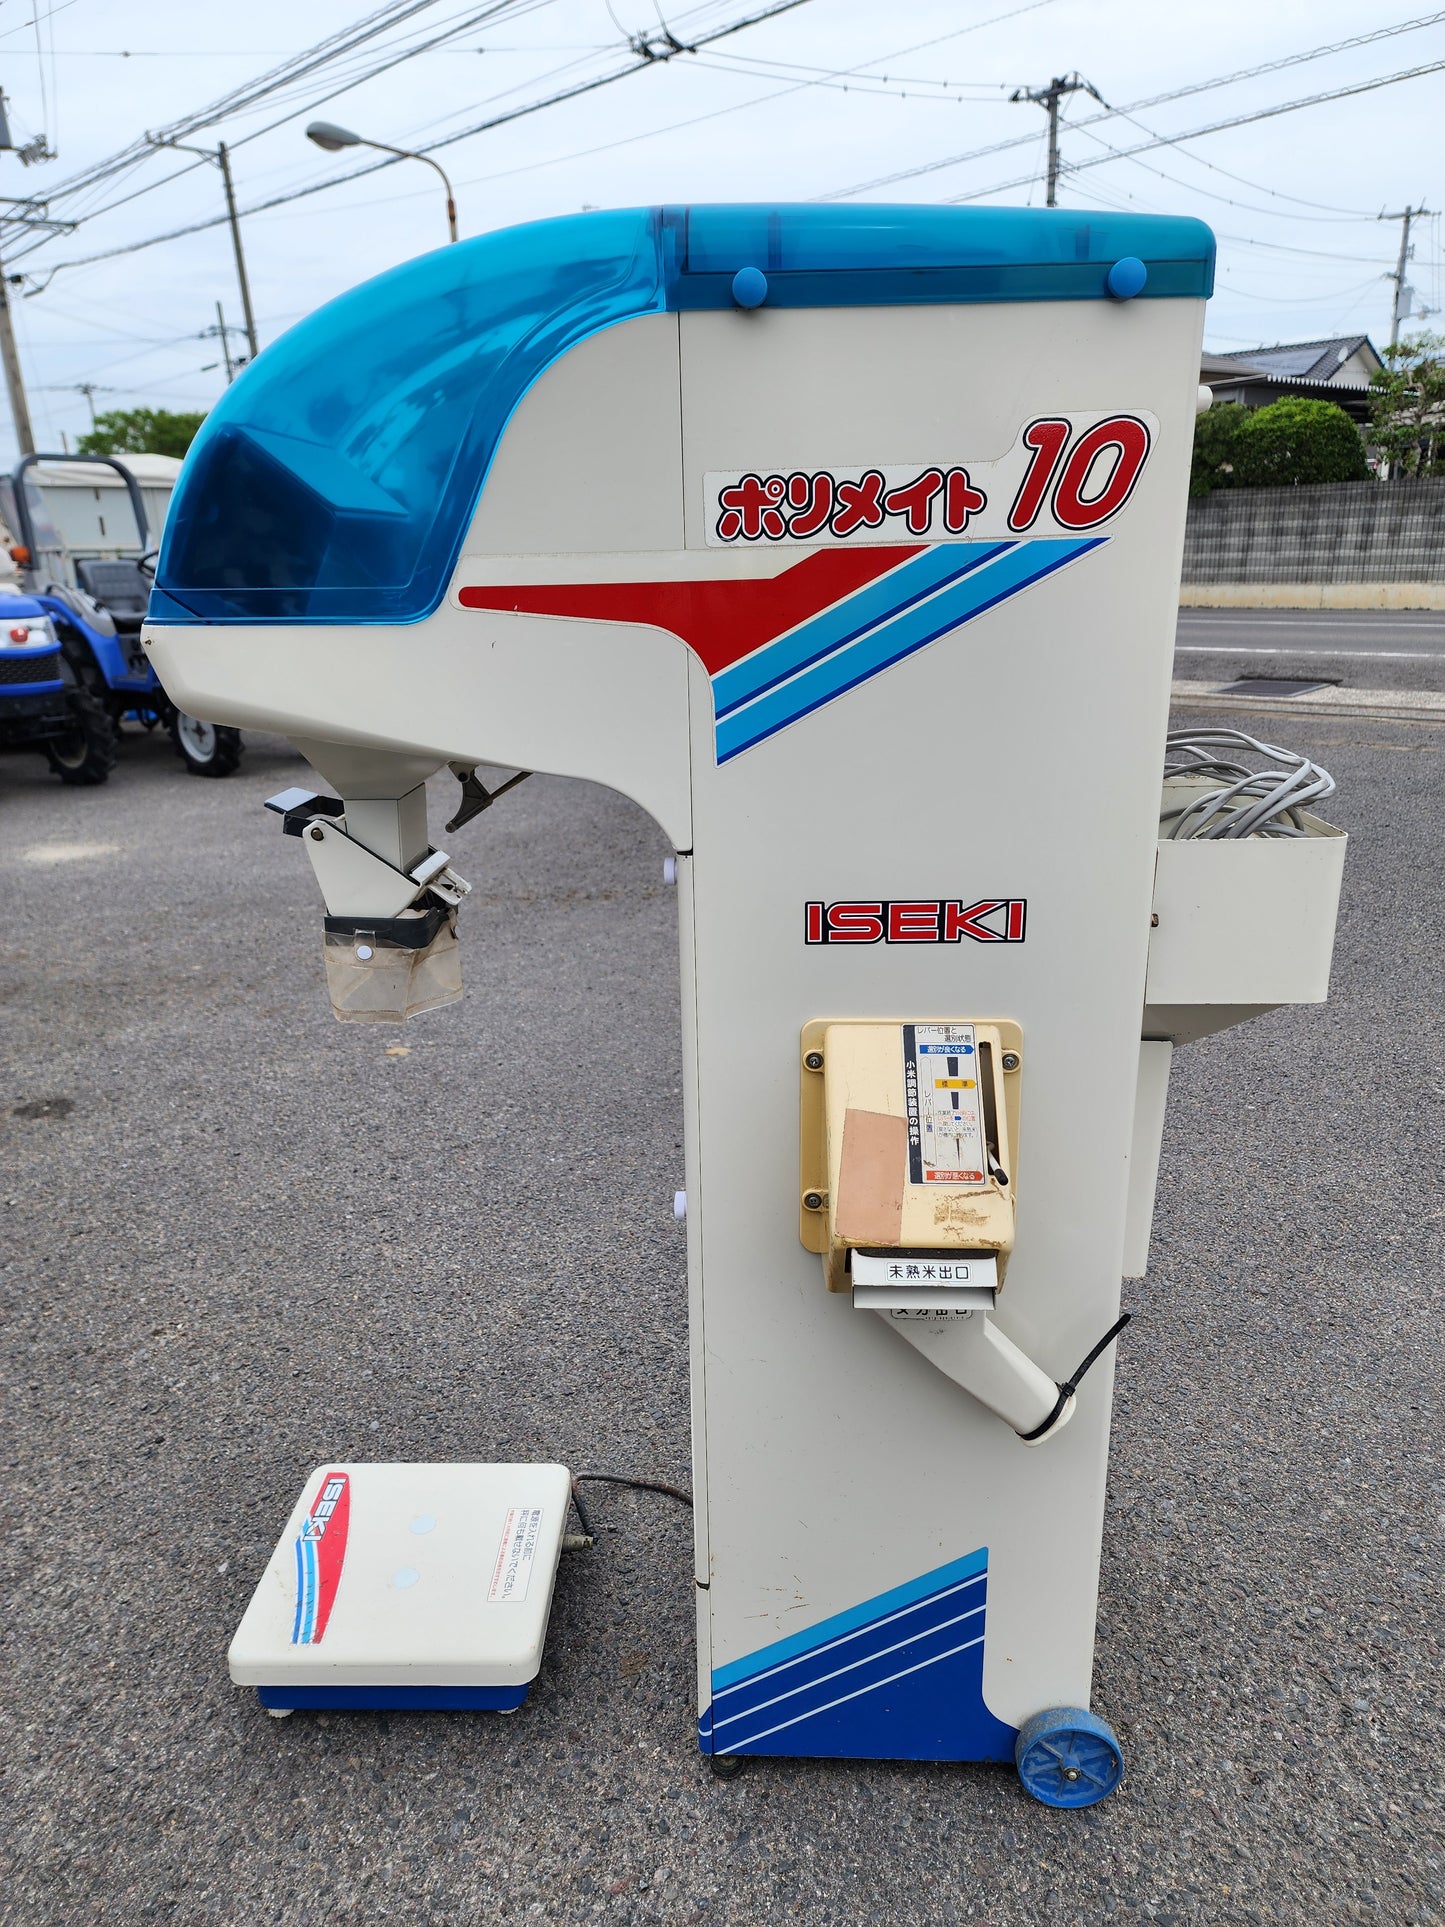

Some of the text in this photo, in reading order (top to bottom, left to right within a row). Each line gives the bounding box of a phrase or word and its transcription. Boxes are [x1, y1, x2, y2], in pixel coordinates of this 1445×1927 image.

[716, 414, 1151, 542] ポリメイト 10
[805, 899, 1027, 945] ISEKI
[906, 1061, 919, 1146] 小米調節装置の操作
[889, 1265, 969, 1280] 未熟米出口
[302, 1478, 348, 1542] ISEKI
